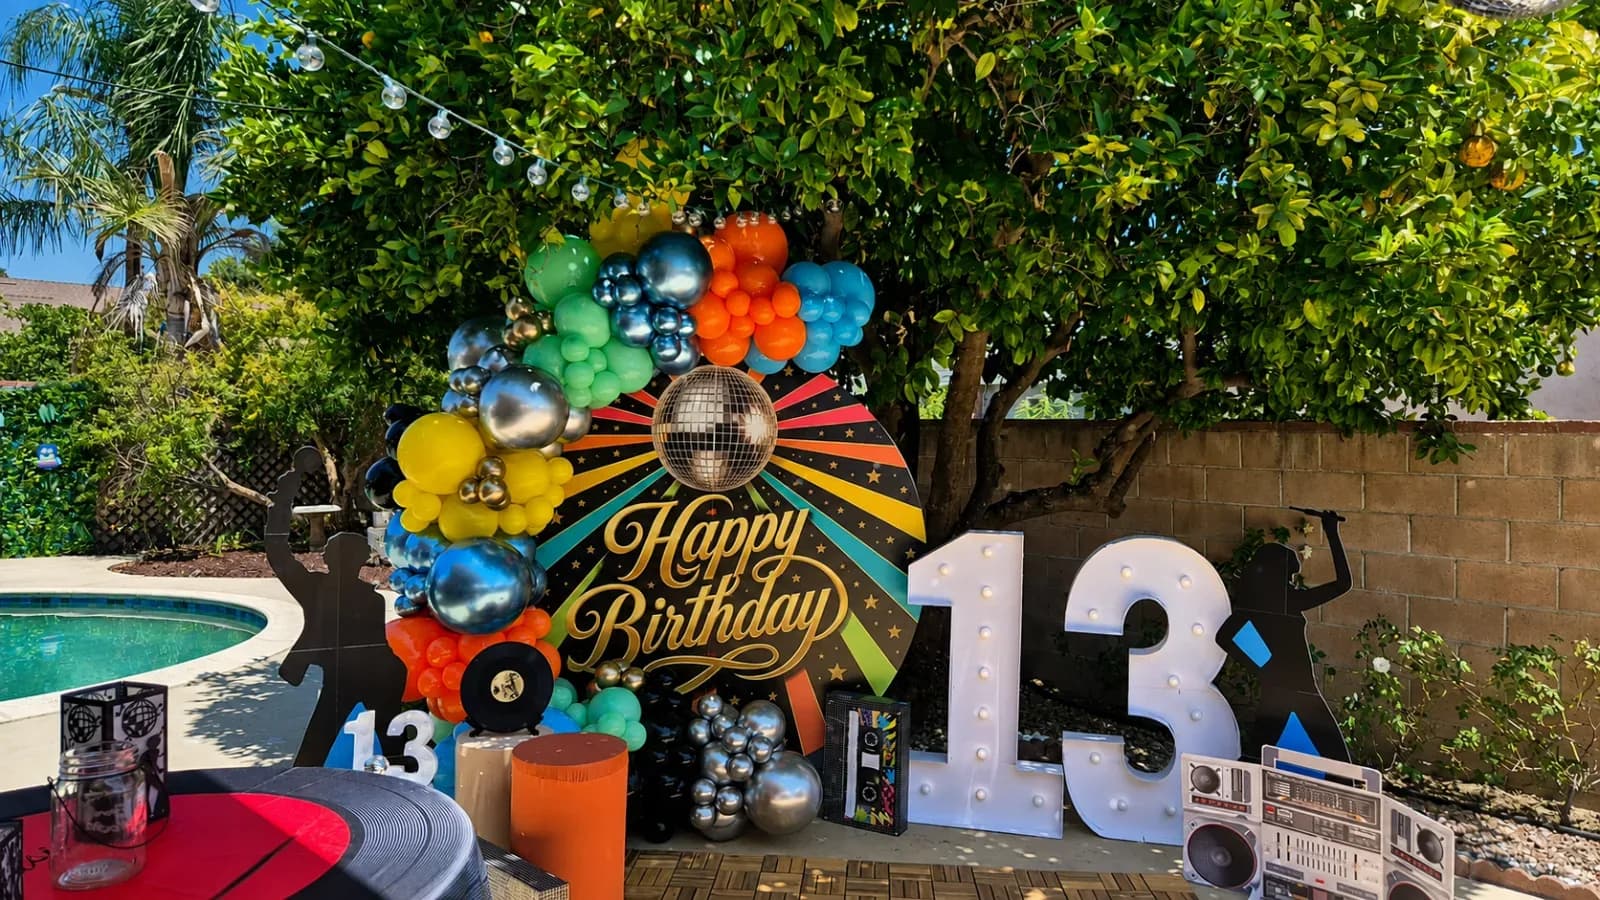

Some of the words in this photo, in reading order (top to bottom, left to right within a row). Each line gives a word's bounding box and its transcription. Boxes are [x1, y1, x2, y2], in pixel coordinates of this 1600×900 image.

[604, 494, 809, 588] Happy
[567, 572, 848, 693] Birthday
[907, 530, 1241, 847] 13
[343, 709, 439, 786] 13
